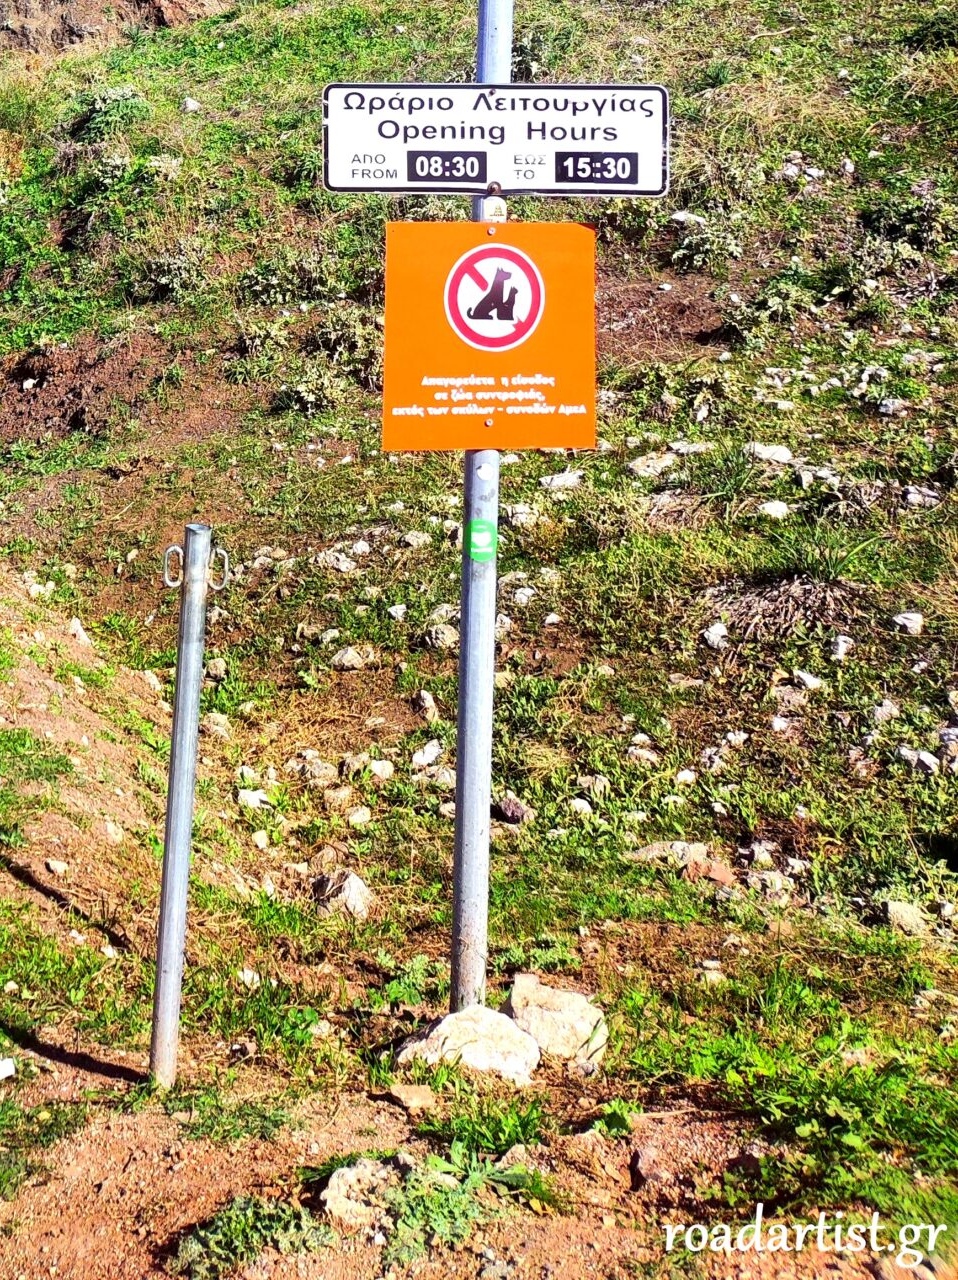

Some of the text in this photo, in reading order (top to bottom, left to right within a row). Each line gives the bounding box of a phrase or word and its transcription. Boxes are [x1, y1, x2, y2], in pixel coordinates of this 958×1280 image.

[344, 92, 654, 117] Ωράριο Λειτουργίας
[377, 120, 618, 145] Opening Hours
[415, 155, 480, 178] 08:30
[513, 154, 547, 166] ΕΩΣ
[351, 168, 398, 179] FROM
[514, 169, 535, 180] TO
